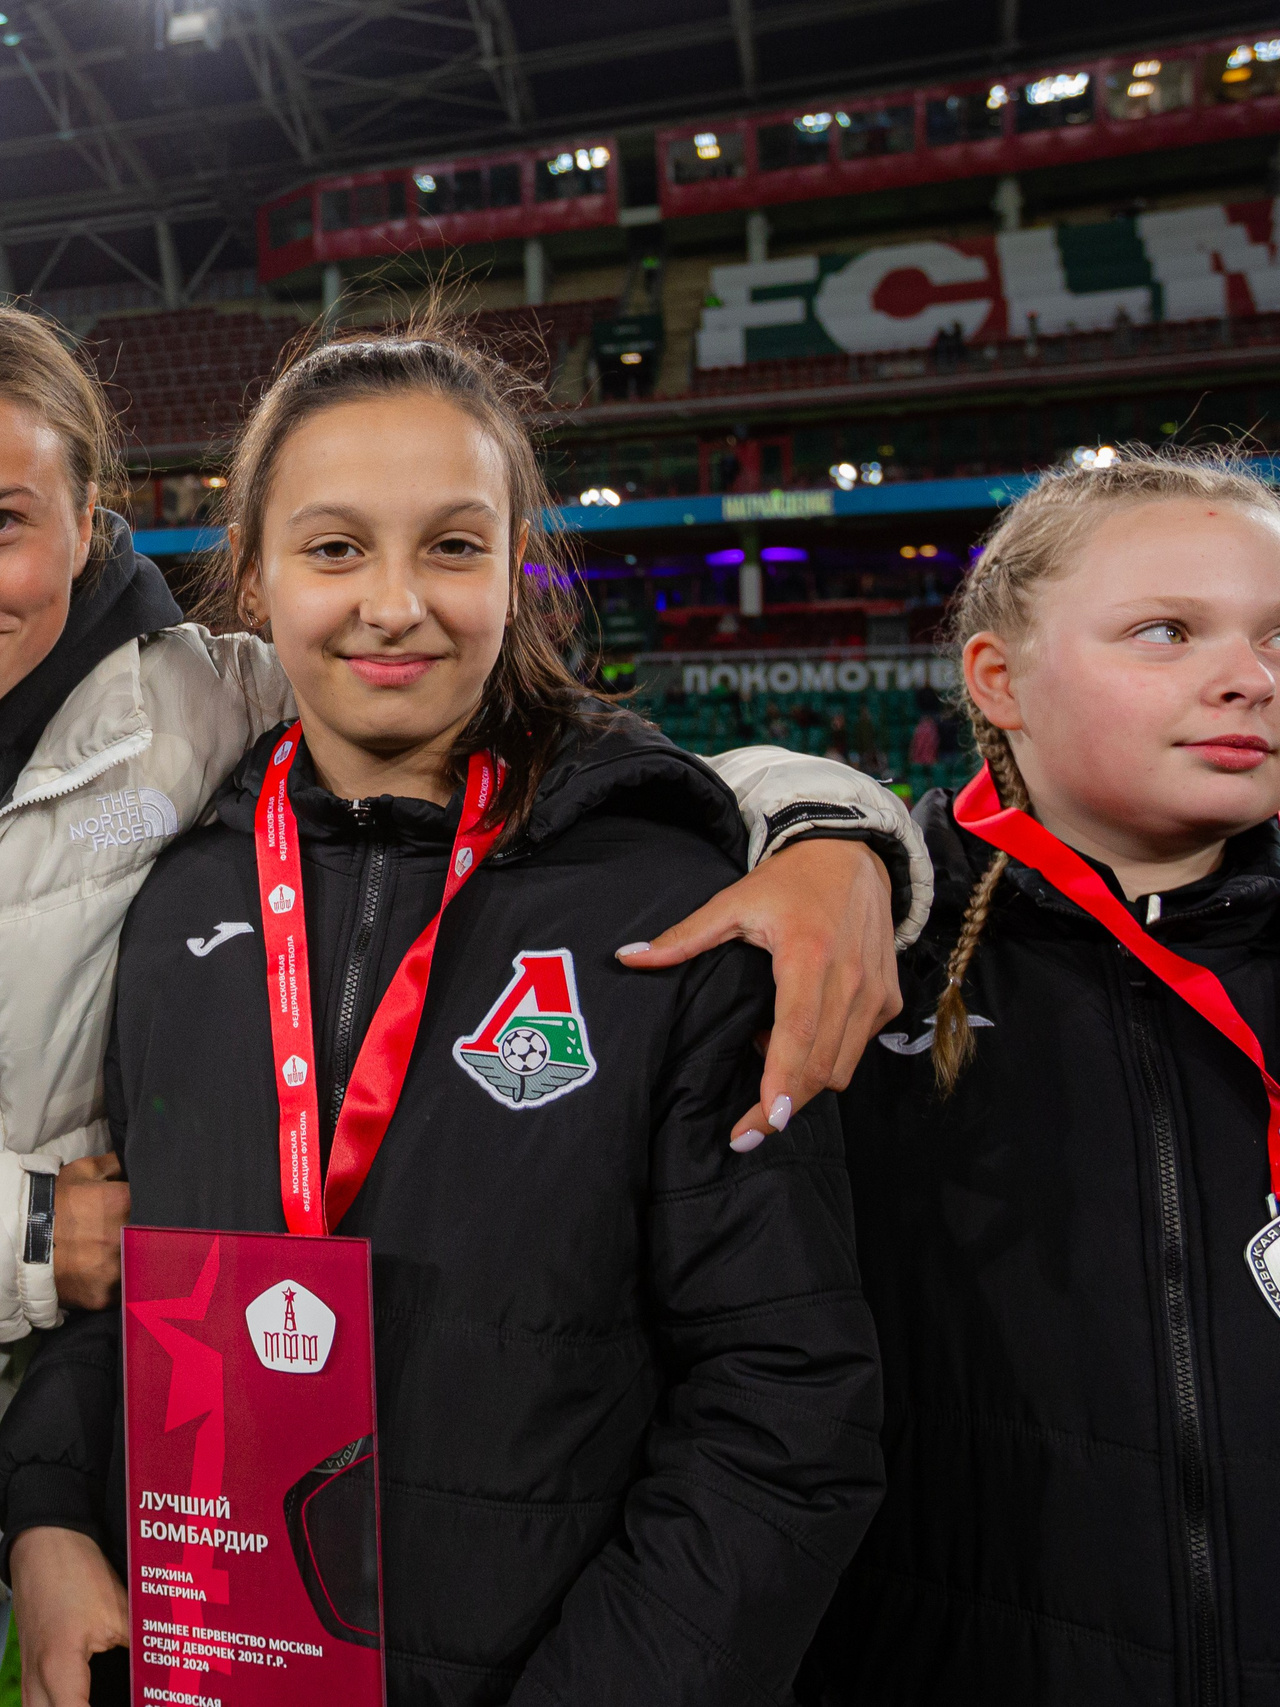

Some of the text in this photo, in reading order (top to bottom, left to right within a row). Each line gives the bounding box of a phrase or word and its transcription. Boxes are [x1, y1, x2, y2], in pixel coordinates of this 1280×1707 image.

[96, 789, 139, 813] THE
[68, 806, 141, 841] NORTH
[91, 823, 144, 852] FACE
[267, 796, 275, 848] МОСКОВСКАЯ
[278, 813, 287, 861] ФЕДЕРАЦИЯ
[278, 954, 288, 1013] МОСКОВСКАЯ
[287, 935, 299, 1029] ФЕДЕРАЦИЯ ФУТБОЛА
[290, 1130, 299, 1194] МОСКОВСКАЯ
[302, 1156, 310, 1212] ФЕДЕРАЦИЯ
[139, 1490, 231, 1519] ЛУЧШИЙ
[140, 1519, 269, 1555] БОМБАРДИР
[141, 1565, 194, 1584] БУРХИНА
[141, 1581, 207, 1602] ЕКАТЕРИНА
[142, 1619, 323, 1657] ЗИМНЕЕ ПЕРВЕНСТВО МОСКВЫ
[142, 1635, 287, 1668] СРЕДИ ДЕВОЧЕК 2012 Г.Р.
[143, 1651, 210, 1672] СЕЗОН 2024
[143, 1686, 222, 1707] МОСКОВСКАЯ
